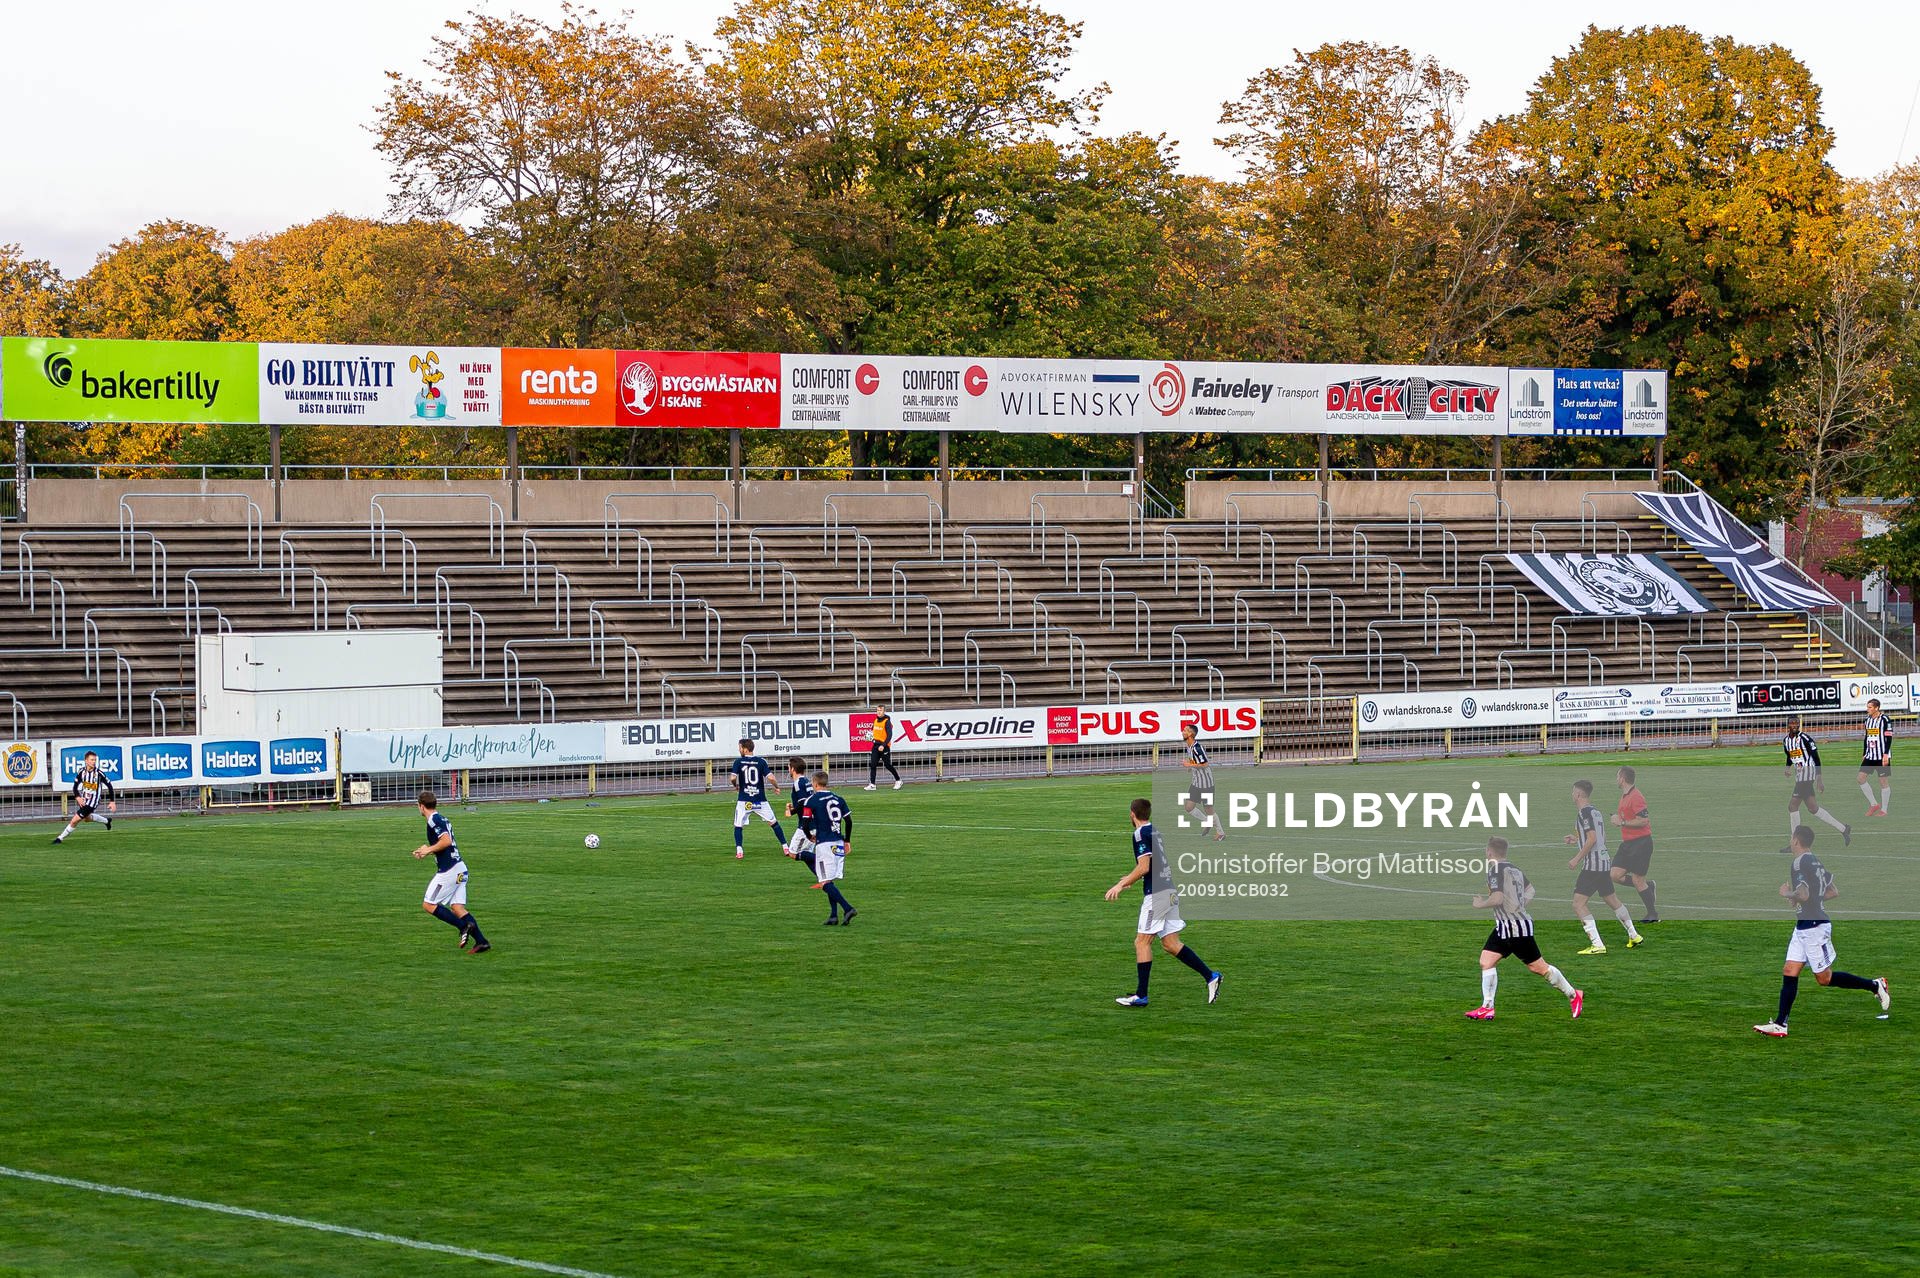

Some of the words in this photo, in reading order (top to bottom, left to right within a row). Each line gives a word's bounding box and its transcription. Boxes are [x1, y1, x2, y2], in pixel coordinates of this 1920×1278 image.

[267, 359, 296, 386] GO
[302, 356, 396, 387] BILTVÄTT
[459, 363, 470, 373] NU
[472, 361, 492, 373] ÄVEN
[468, 376, 484, 386] MED
[521, 365, 598, 394] renta
[792, 368, 851, 390] COMFORT
[902, 370, 960, 391] COMFORT
[1000, 372, 1087, 383] ADVOKATFIRMAN
[1557, 377, 1578, 390] Plats
[1579, 378, 1592, 390] att
[1593, 378, 1620, 390] verka?
[82, 369, 220, 408] bakertilly
[284, 389, 334, 401] VÄLKOMMEN
[336, 391, 351, 401] TILL
[353, 392, 378, 402] STANS
[464, 389, 488, 399] HUND-
[1191, 377, 1274, 403] Faiveley
[1276, 386, 1320, 400] Transport
[528, 398, 590, 406] MASKINUTHYRNING
[662, 396, 666, 408] I
[667, 393, 702, 408] SKÅNE
[792, 394, 834, 405] CARL-PHILIPS
[836, 395, 849, 406] VVS
[902, 395, 944, 407] CARL-PHILIPS
[945, 395, 958, 407] VVS
[1326, 380, 1402, 413] DÄCK
[1429, 386, 1501, 413] CITY
[1560, 399, 1575, 408] -Det
[1576, 399, 1598, 408] verkar
[1598, 399, 1618, 408] bättre
[299, 403, 324, 414] BÄSTA
[326, 403, 365, 415] BILTVÄTT!
[463, 401, 489, 412] TVÄTT!
[1000, 392, 1140, 417] WILENSKY
[1188, 408, 1194, 416] A
[1195, 406, 1227, 416] Wabtec
[1227, 408, 1256, 417] Company
[791, 408, 841, 422] CENTRALVÄRME
[902, 409, 950, 423] CENTRALVÄRME
[1326, 413, 1380, 421] LANDSKRONA
[1467, 413, 1484, 422] 209
[1509, 408, 1551, 419] Lindström
[1575, 411, 1588, 420] hos
[1588, 411, 1602, 420] oss!
[1624, 409, 1664, 420] Lindström
[1665, 696, 1681, 704] RASK
[1681, 696, 1687, 704] &
[1736, 682, 1840, 704] InfoChannel
[1382, 705, 1453, 716] vwlandskrona.se
[1481, 701, 1550, 713] vwlandskrona.se
[1560, 701, 1576, 709] RASK
[1080, 710, 1160, 736] PULS
[1179, 707, 1257, 732] PULS
[628, 723, 715, 745] BOLIDEN
[747, 718, 832, 740] BOLIDEN
[925, 716, 1036, 740] expoline
[389, 734, 443, 769] Upplev
[442, 732, 517, 763] Landskrona
[517, 734, 527, 754] &
[528, 727, 557, 759] Ven
[136, 753, 189, 771] Haldex
[206, 751, 257, 769] Haldex
[274, 748, 323, 766] Haldex
[741, 765, 759, 785] 10
[826, 799, 842, 821] 6
